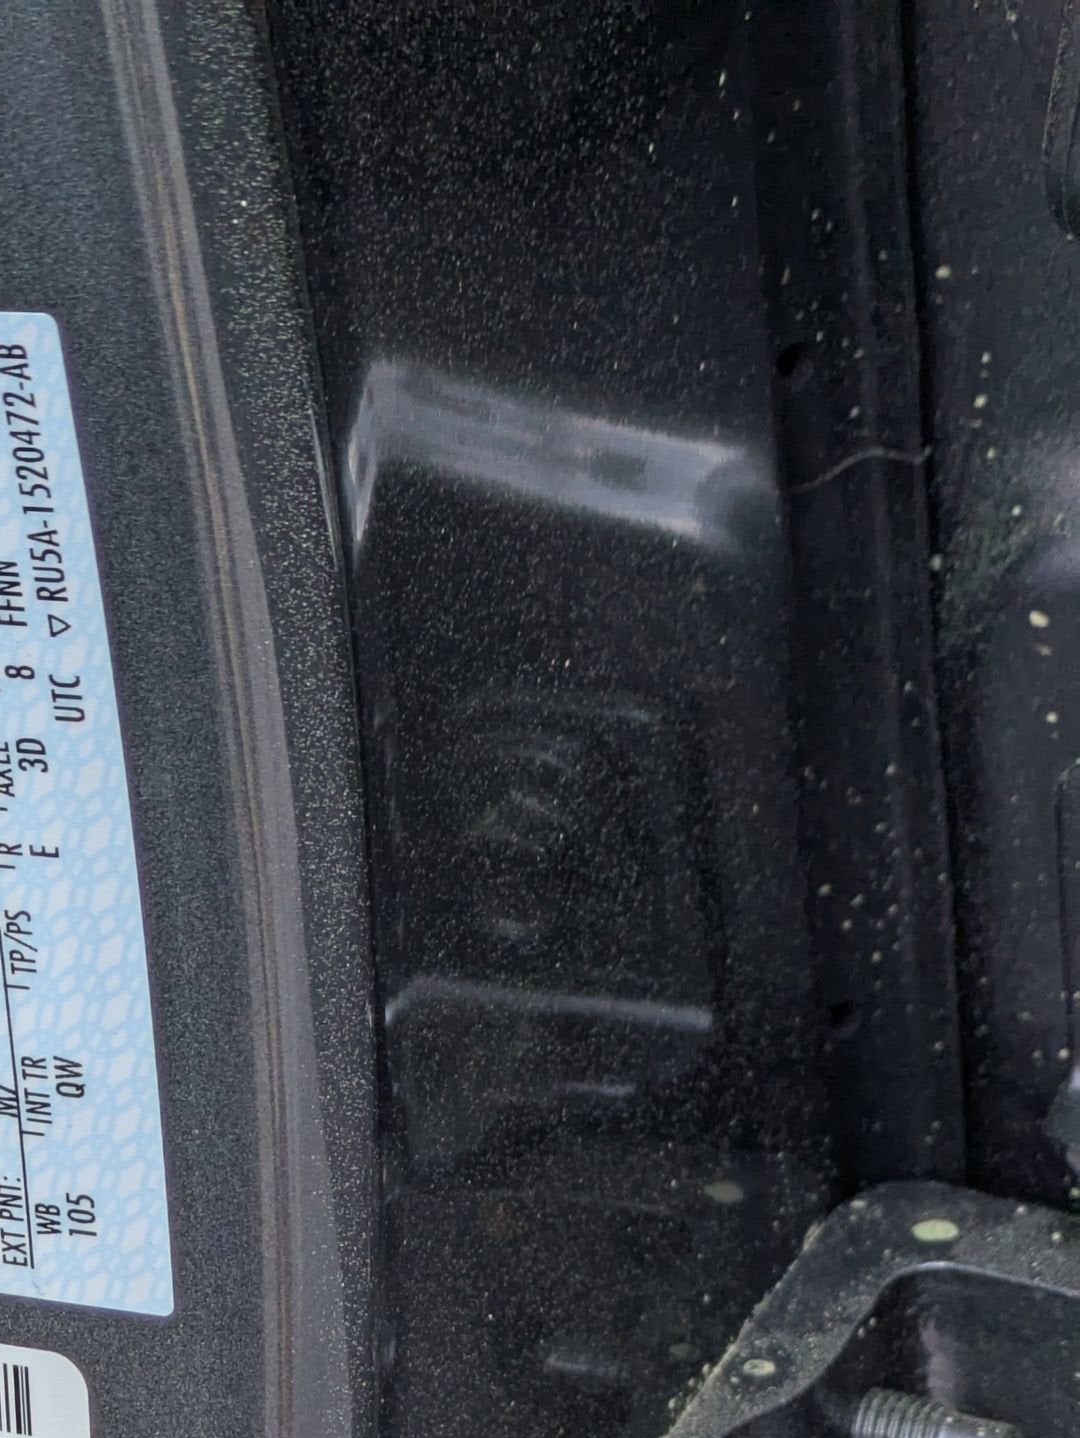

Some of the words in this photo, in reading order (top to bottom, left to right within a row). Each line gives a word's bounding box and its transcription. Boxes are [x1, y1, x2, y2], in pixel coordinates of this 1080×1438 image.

[48, 674, 85, 722] UTC
[15, 737, 48, 773] 3D
[3, 909, 38, 975] TP/PS
[20, 1056, 48, 1080] TR
[52, 1055, 86, 1098] QW
[23, 1087, 53, 1124] INT
[34, 1202, 62, 1235] WB
[65, 1192, 97, 1237] 105
[0, 1227, 28, 1267] EXT
